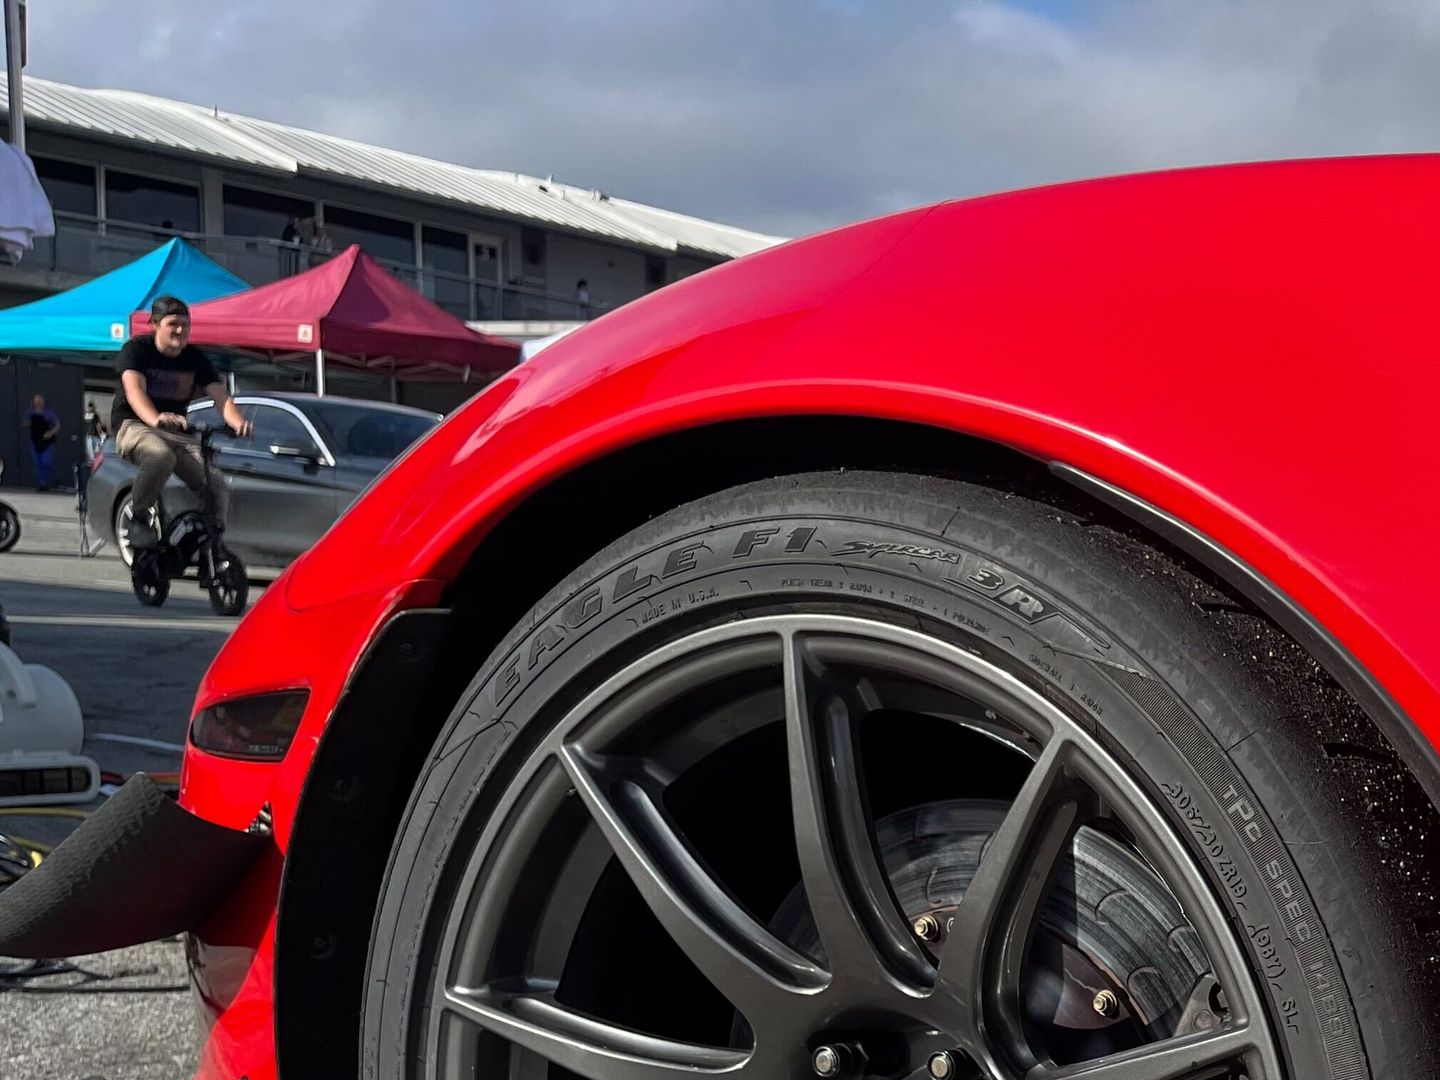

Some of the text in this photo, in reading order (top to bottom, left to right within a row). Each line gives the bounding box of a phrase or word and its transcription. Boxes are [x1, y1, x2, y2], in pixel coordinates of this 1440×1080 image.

[494, 541, 705, 707] EAGLE
[731, 525, 817, 558] F1
[641, 604, 666, 625] MADE
[671, 596, 682, 611] IN
[1220, 784, 1264, 843] TPC
[1265, 859, 1313, 942] SPEC
